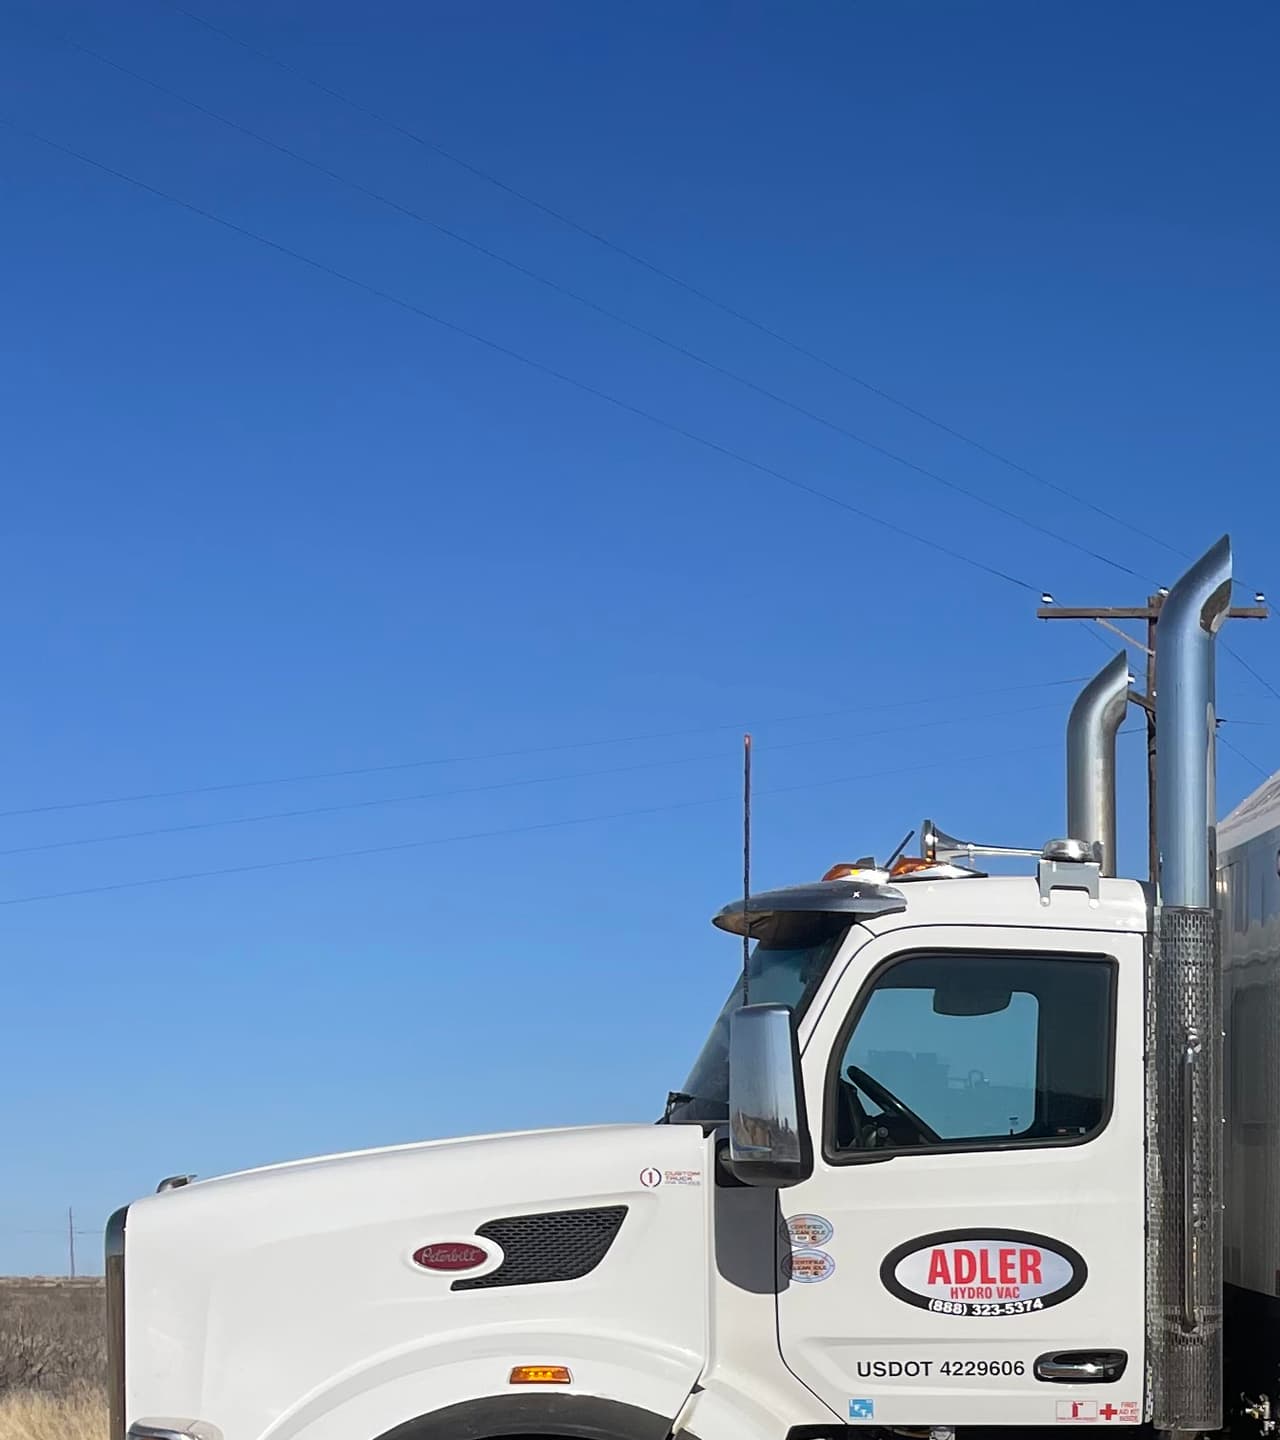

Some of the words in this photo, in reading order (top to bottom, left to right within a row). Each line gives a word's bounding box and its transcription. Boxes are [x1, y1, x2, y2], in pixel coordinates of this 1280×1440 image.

[421, 1247, 481, 1264] Peterbilt
[927, 1248, 1043, 1285] ADLER
[950, 1286, 993, 1300] HYDRO
[996, 1286, 1021, 1299] VAC
[928, 1298, 968, 1316] (888)
[971, 1298, 1044, 1316] 323-5374
[857, 1361, 933, 1377] USDOT
[939, 1360, 1025, 1377] 4229606
